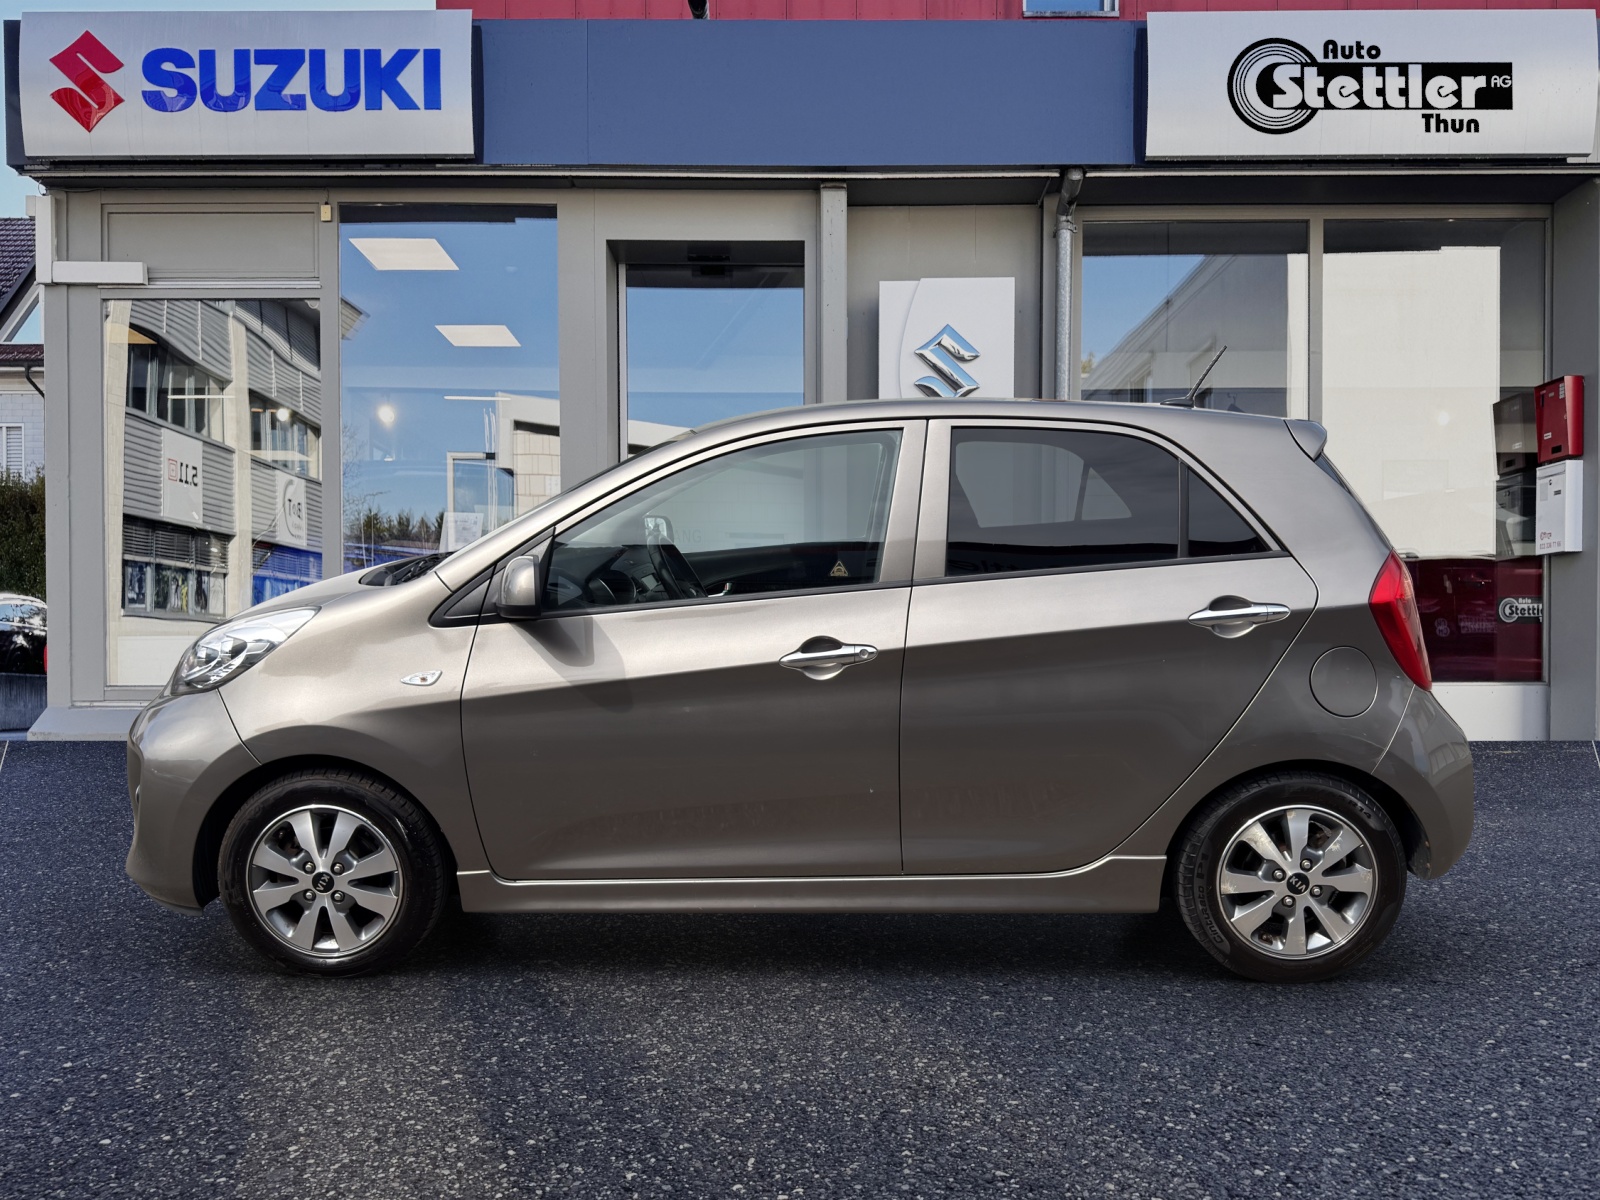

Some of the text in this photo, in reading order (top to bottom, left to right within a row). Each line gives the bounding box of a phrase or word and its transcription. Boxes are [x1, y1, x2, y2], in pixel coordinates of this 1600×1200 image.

[1323, 39, 1381, 60] Auto
[141, 47, 442, 112] SUZUKI
[1272, 63, 1512, 109] Stettler AG
[1421, 113, 1480, 133] Thun
[315, 873, 330, 891] KIA
[1289, 875, 1307, 892] KIA
